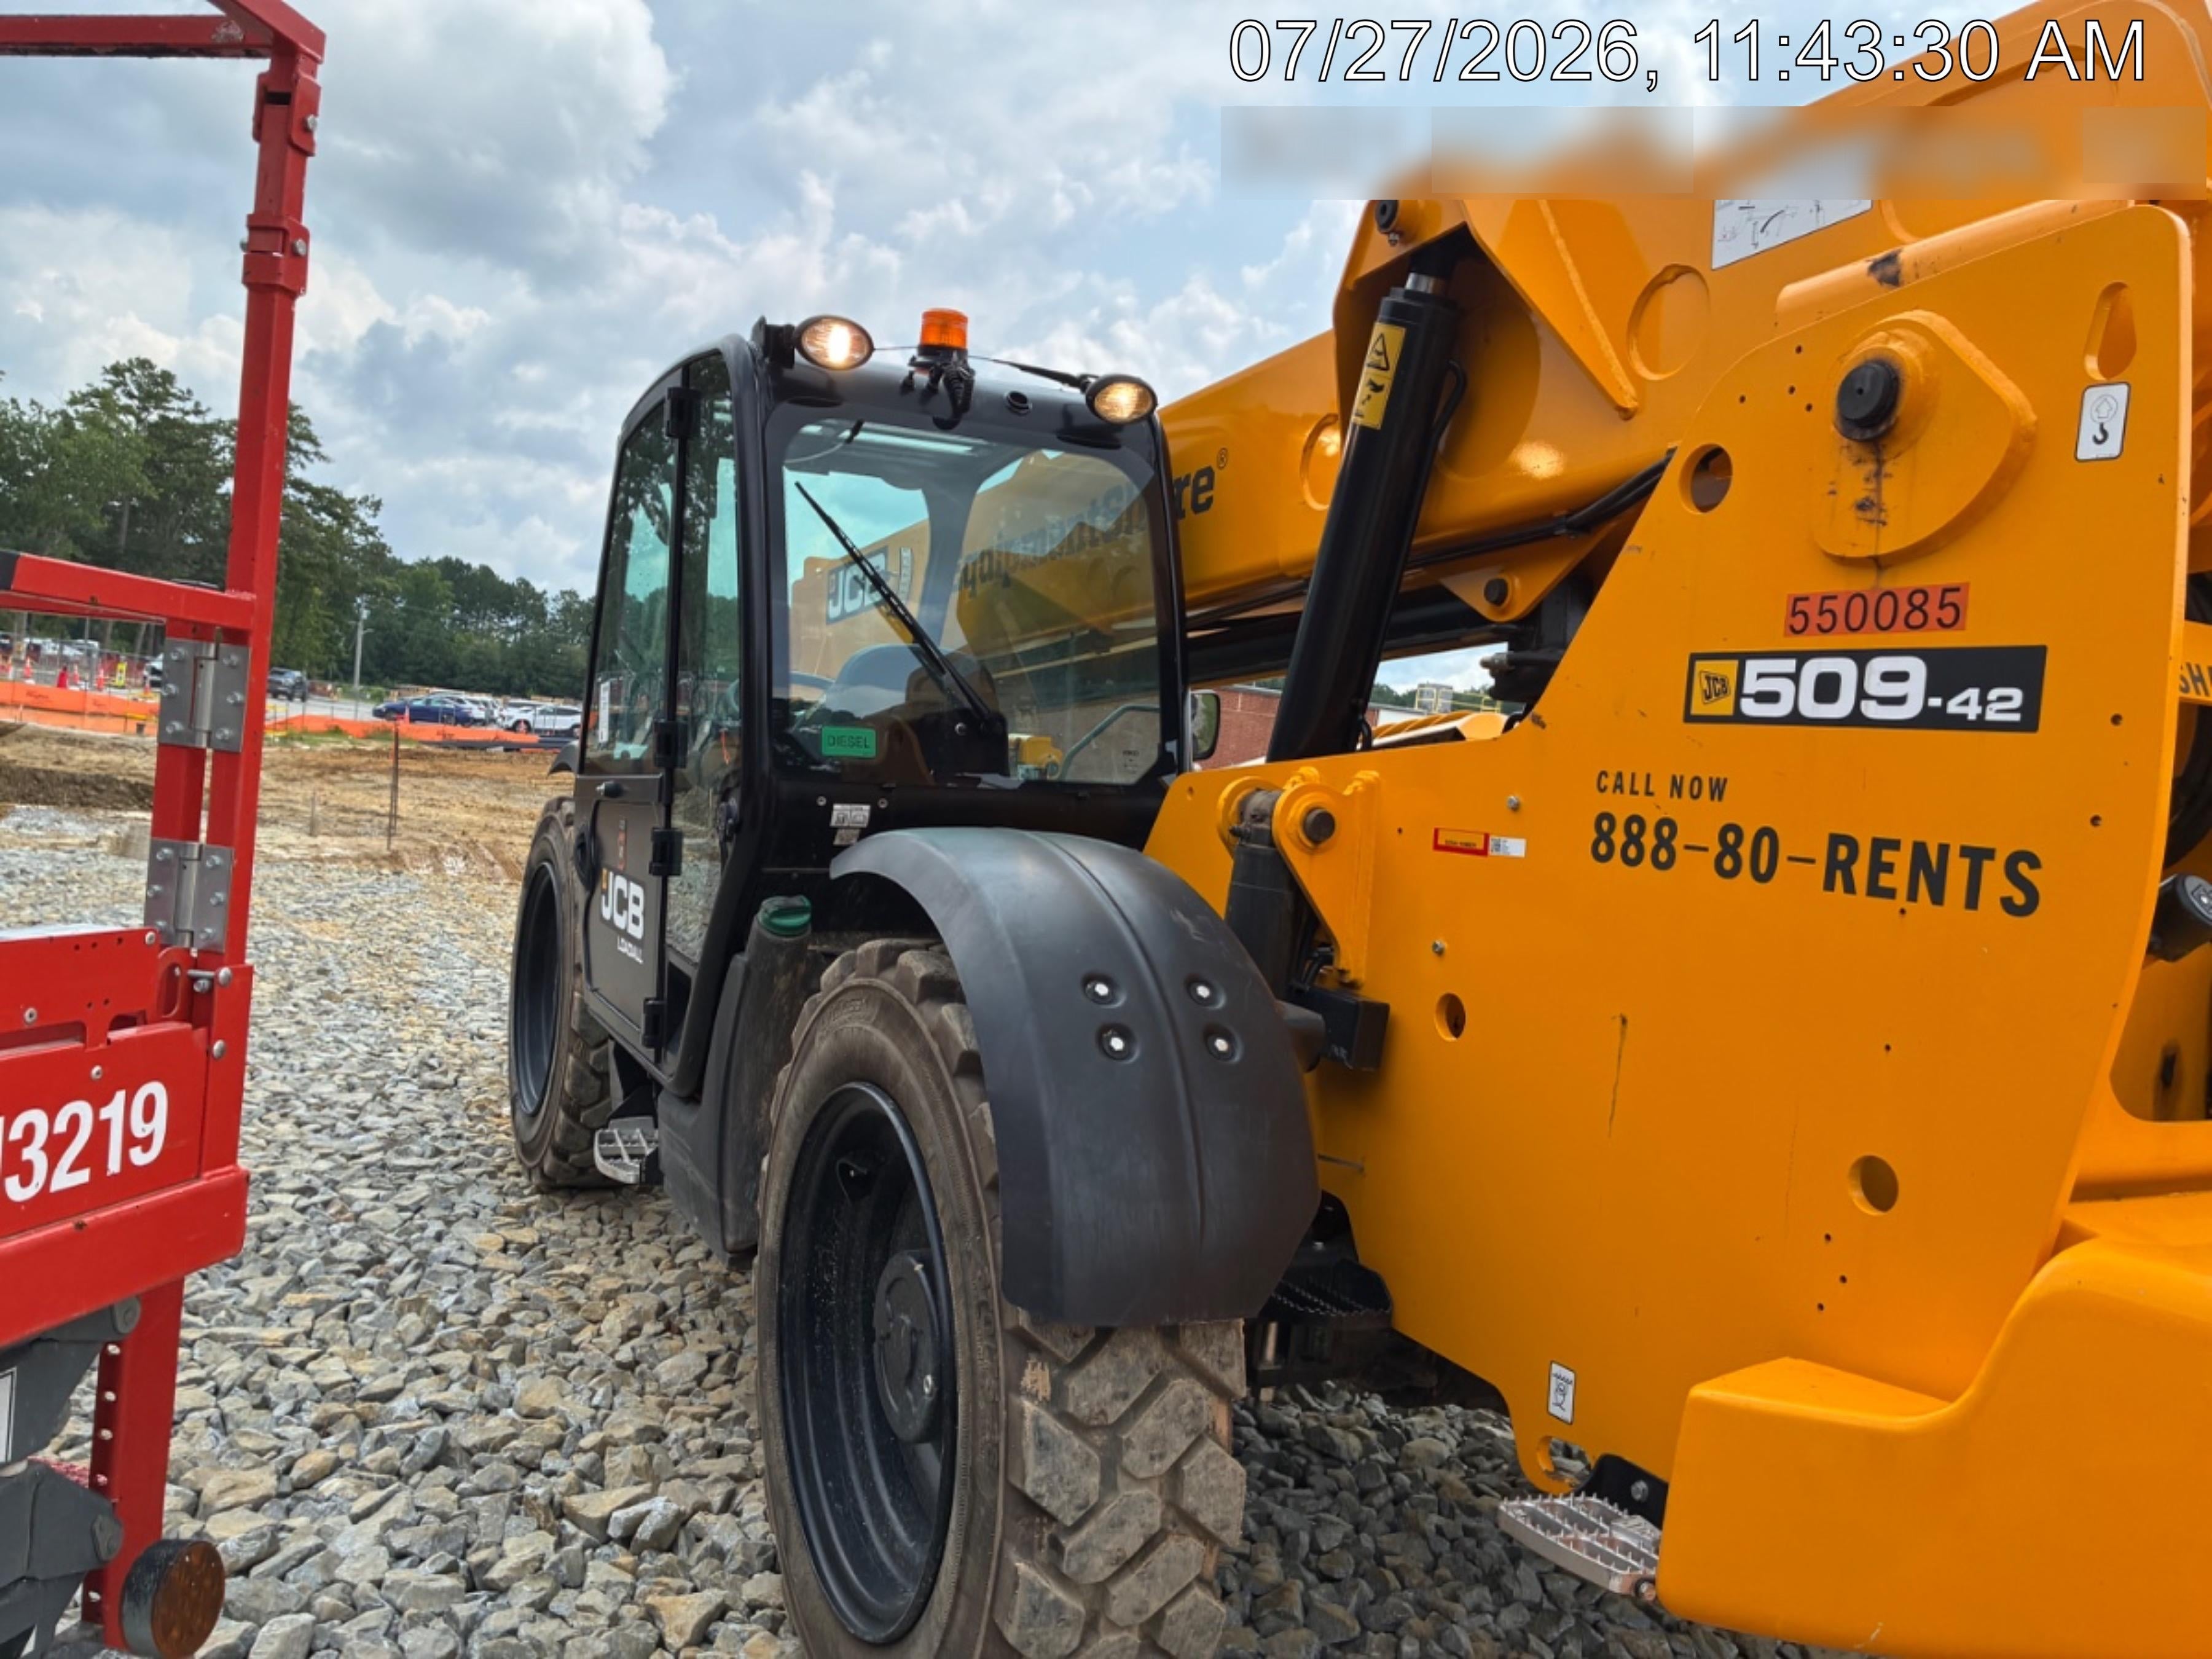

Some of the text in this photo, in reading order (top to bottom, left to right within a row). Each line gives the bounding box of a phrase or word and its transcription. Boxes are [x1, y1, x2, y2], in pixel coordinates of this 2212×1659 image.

[1789, 586, 1961, 635] 550085
[1703, 655, 2023, 722] JCB 509-42
[827, 735, 870, 749] DIESEL
[1596, 770, 1728, 802] CALL NOW
[1590, 812, 2043, 917] 888-80-RENTS
[602, 869, 644, 939] JCB
[0, 1080, 168, 1202] 3219
